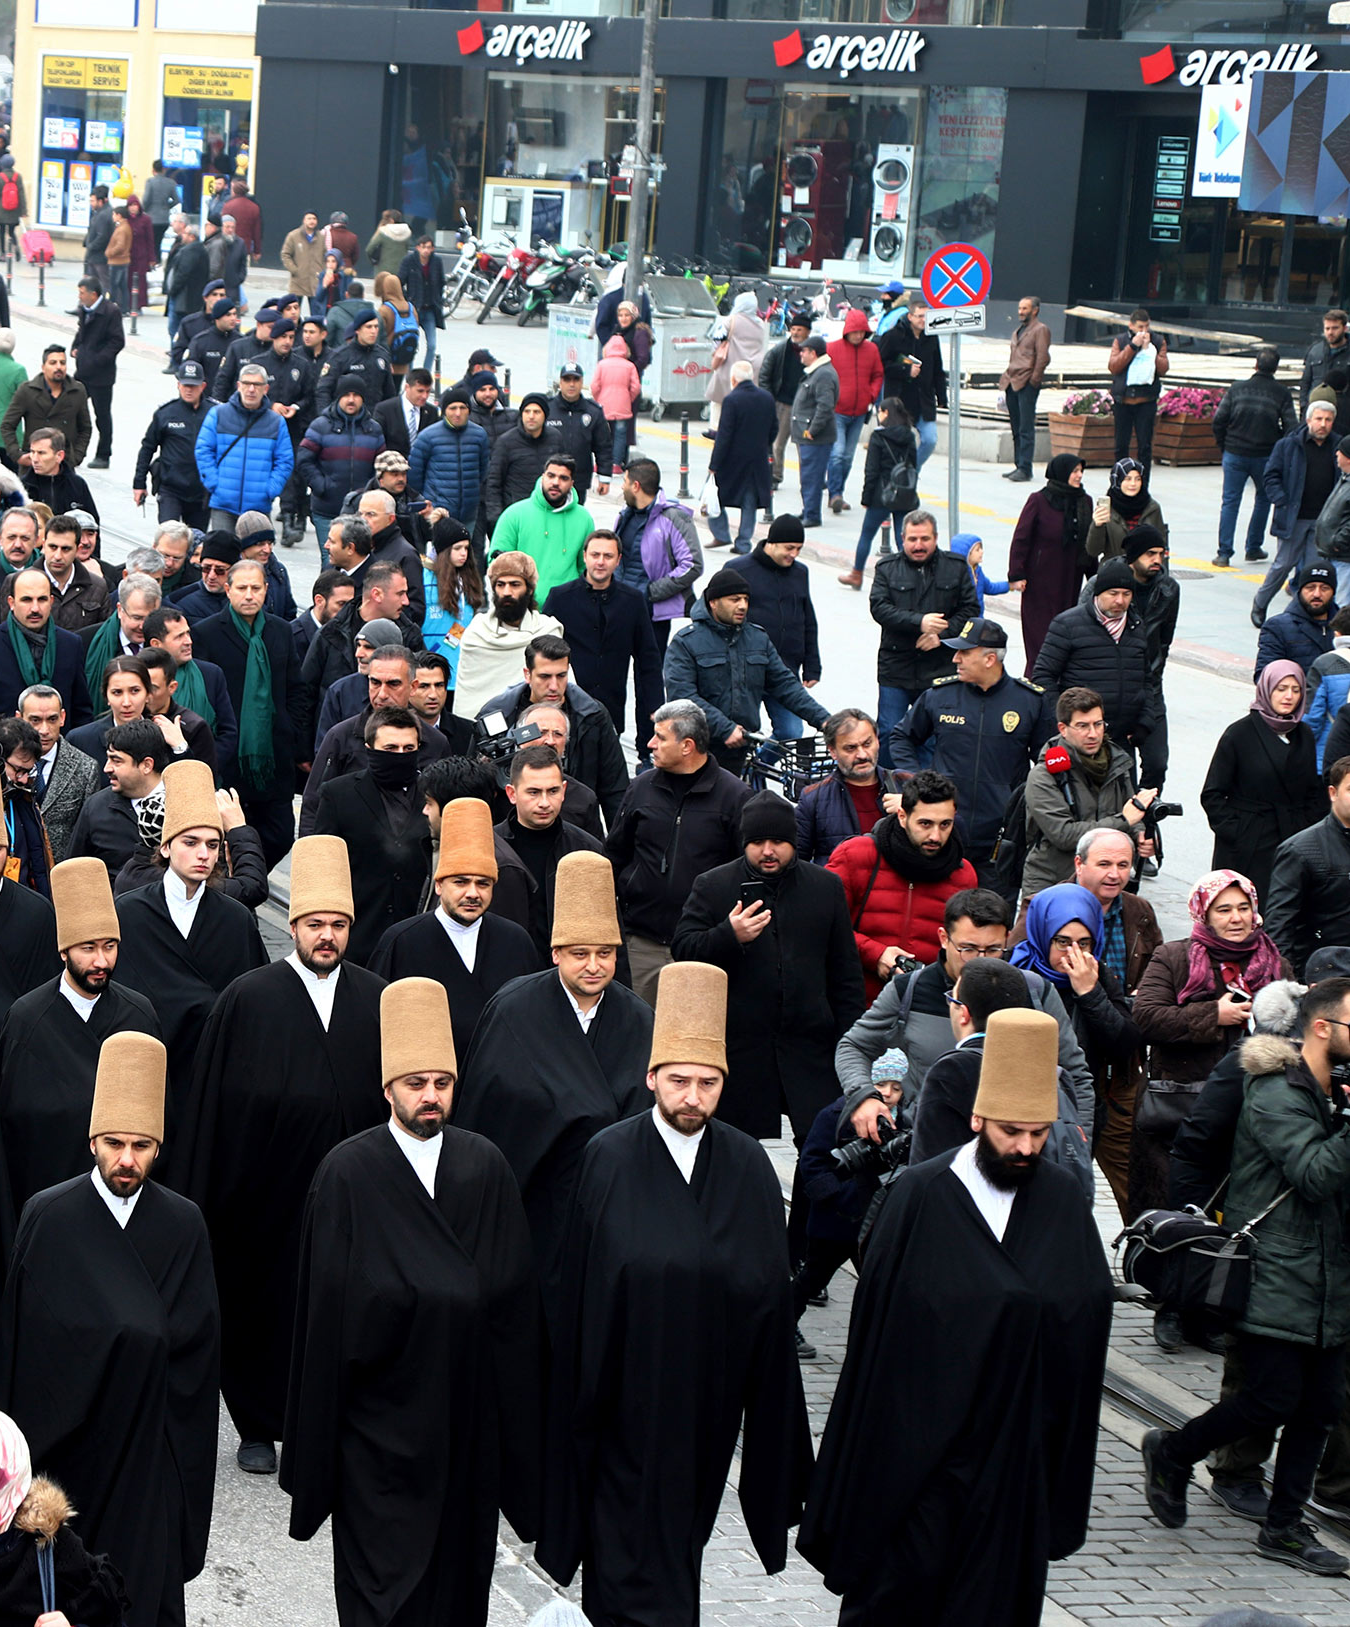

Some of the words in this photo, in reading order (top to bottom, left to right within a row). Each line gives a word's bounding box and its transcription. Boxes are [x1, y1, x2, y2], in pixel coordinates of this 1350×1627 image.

[485, 19, 592, 66] arçelik
[806, 29, 926, 79] arçelik
[93, 62, 121, 74] TEKNİK
[92, 75, 121, 87] SERVİS
[1156, 200, 1178, 208] Lenovo
[1047, 756, 1067, 766] DHA
